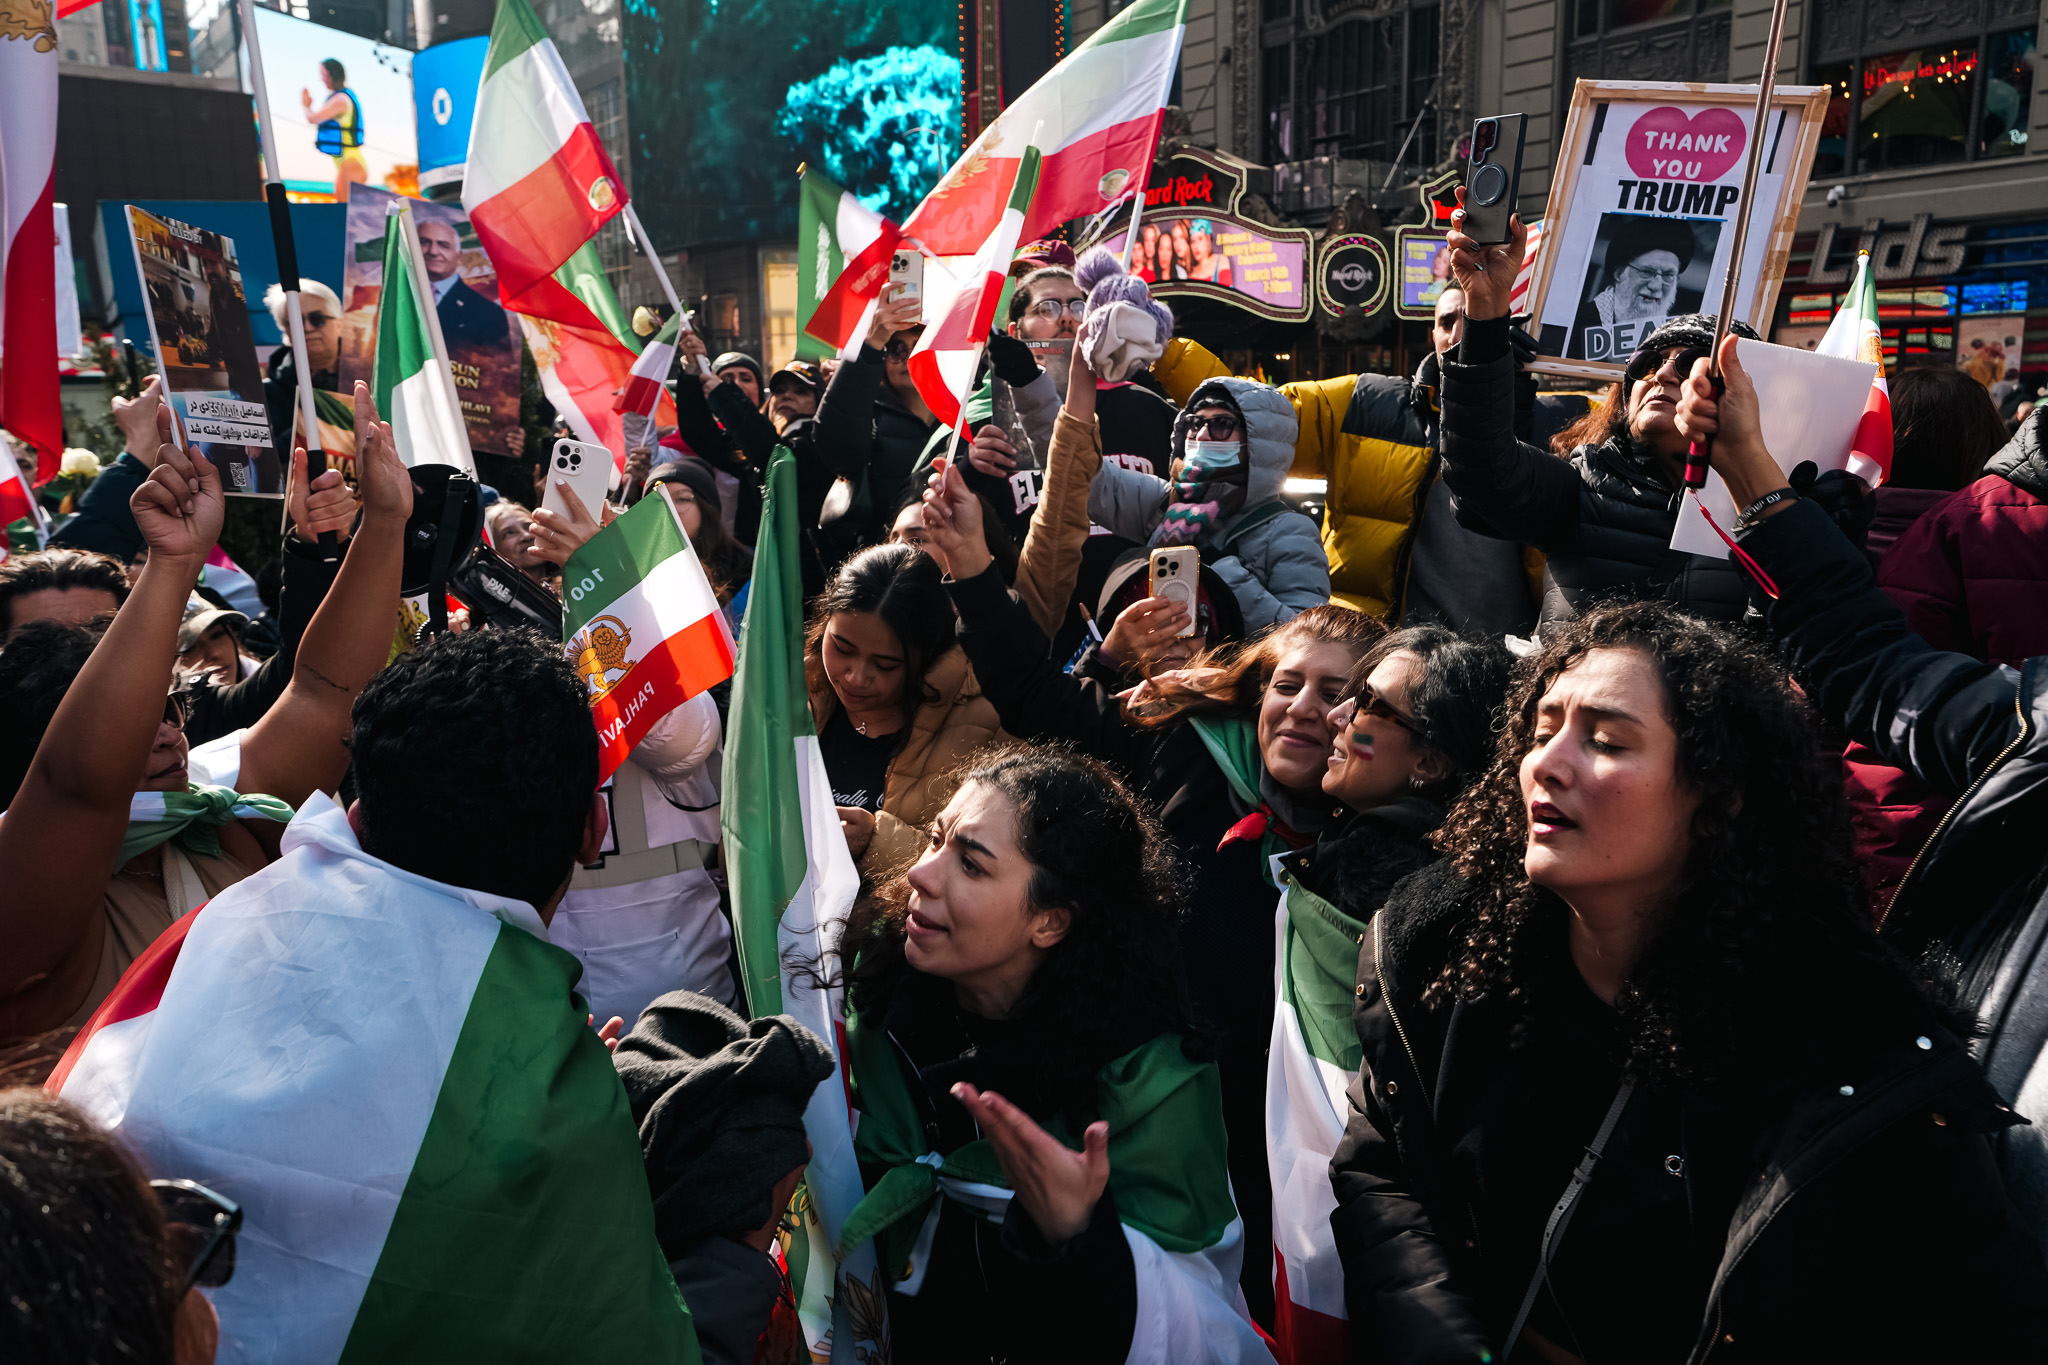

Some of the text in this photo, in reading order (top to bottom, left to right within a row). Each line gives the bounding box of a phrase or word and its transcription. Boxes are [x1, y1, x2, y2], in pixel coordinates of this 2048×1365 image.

[1645, 131, 1731, 154] THANK
[1652, 158, 1702, 179] YOU
[1144, 172, 1214, 207] ard Rock
[1617, 179, 1740, 216] TRUMP
[168, 225, 193, 242] KILLED
[1807, 213, 1969, 284] Lids
[1584, 318, 1664, 362] DEA
[487, 577, 511, 599] PYLE
[832, 788, 868, 807] cally
